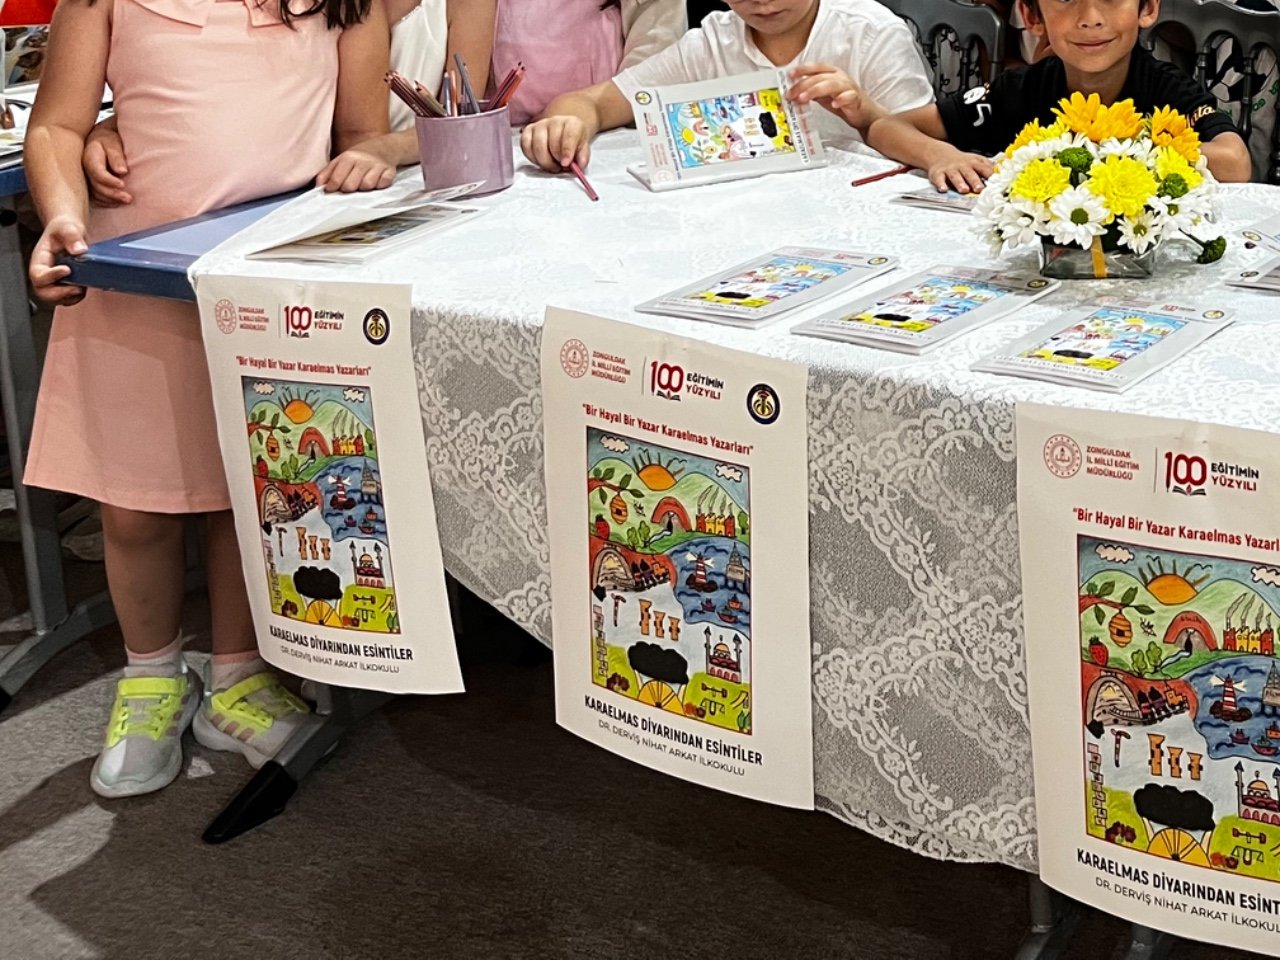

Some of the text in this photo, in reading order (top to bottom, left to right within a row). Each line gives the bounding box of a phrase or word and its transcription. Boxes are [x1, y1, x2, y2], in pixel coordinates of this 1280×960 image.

[284, 305, 313, 331] 100
[651, 361, 684, 393] 100
[686, 372, 724, 390] EĞİTİMİN
[686, 384, 720, 400] YÜZYILI
[599, 407, 621, 423] Hayal
[624, 412, 635, 427] Bir
[637, 416, 660, 433] Yazar
[661, 424, 708, 446] Karaelmas
[1086, 446, 1131, 459] ZONGULDAK
[1164, 451, 1207, 487] 100
[1086, 467, 1133, 481] MÜDÜRLÜĞÜ
[1210, 462, 1259, 479] EĞİTİMİN
[1212, 474, 1257, 492] YÜZYILI
[1096, 511, 1125, 528] Hayal
[1128, 517, 1144, 531] Bir
[1147, 520, 1176, 537] Yazar
[1179, 526, 1242, 545] Karaelmas
[269, 625, 413, 661] KARAELMAS DİYARINDAN ESİNTİLER
[584, 695, 763, 766] KARAELMAS DİYARINDAN ESİNTİLER
[598, 719, 745, 776] DR. DERVİŞ NİHAT ARKAT İLKOKULU
[1077, 848, 1149, 886] KARAELMAS
[1153, 872, 1235, 907] DİYARINDAN
[1095, 876, 1112, 891] DR.
[1114, 884, 1151, 905] DERVİŞ
[1154, 896, 1188, 913] NİHAT
[1191, 906, 1228, 922] ARKAT
